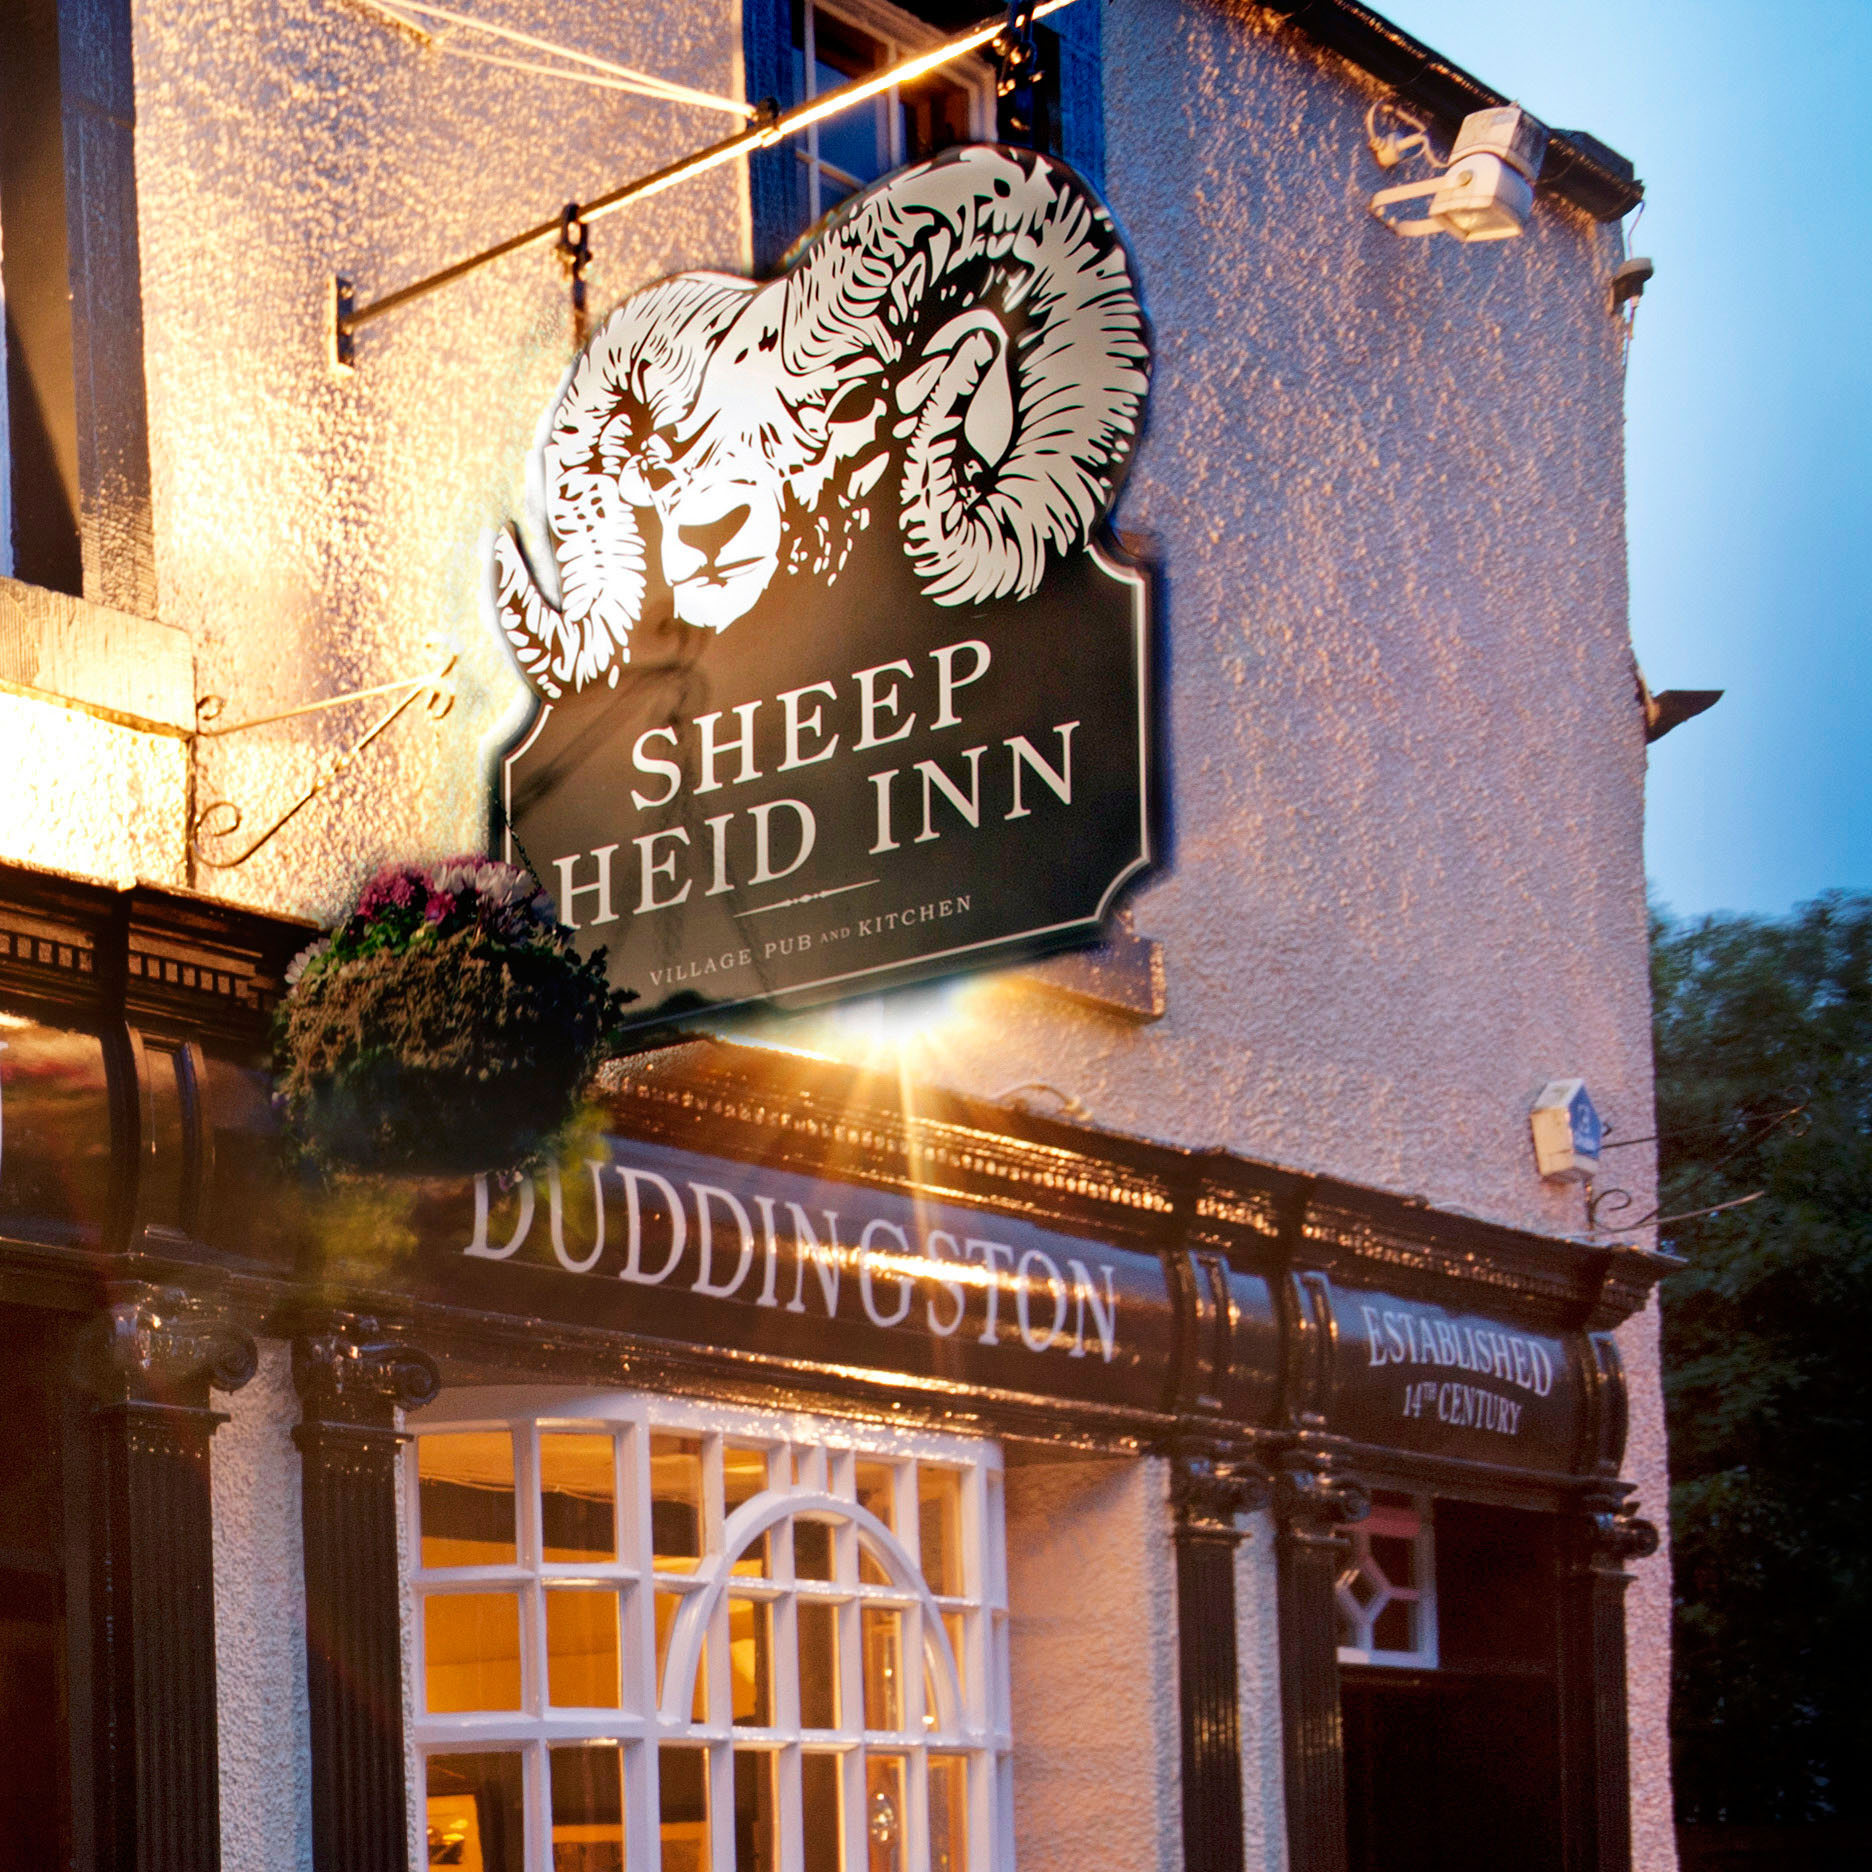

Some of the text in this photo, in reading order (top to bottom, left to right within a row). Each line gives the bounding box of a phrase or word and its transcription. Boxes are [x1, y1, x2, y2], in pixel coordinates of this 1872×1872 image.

[629, 639, 992, 811] SHEEP
[552, 720, 1081, 931] HEID INN
[649, 894, 973, 987] VILLAGE PUB AND KITCHEN
[462, 1157, 1117, 1364] DUDDINGSTON
[1360, 1304, 1554, 1398] ESTABLISHED
[1438, 1382, 1523, 1435] CENTURY
